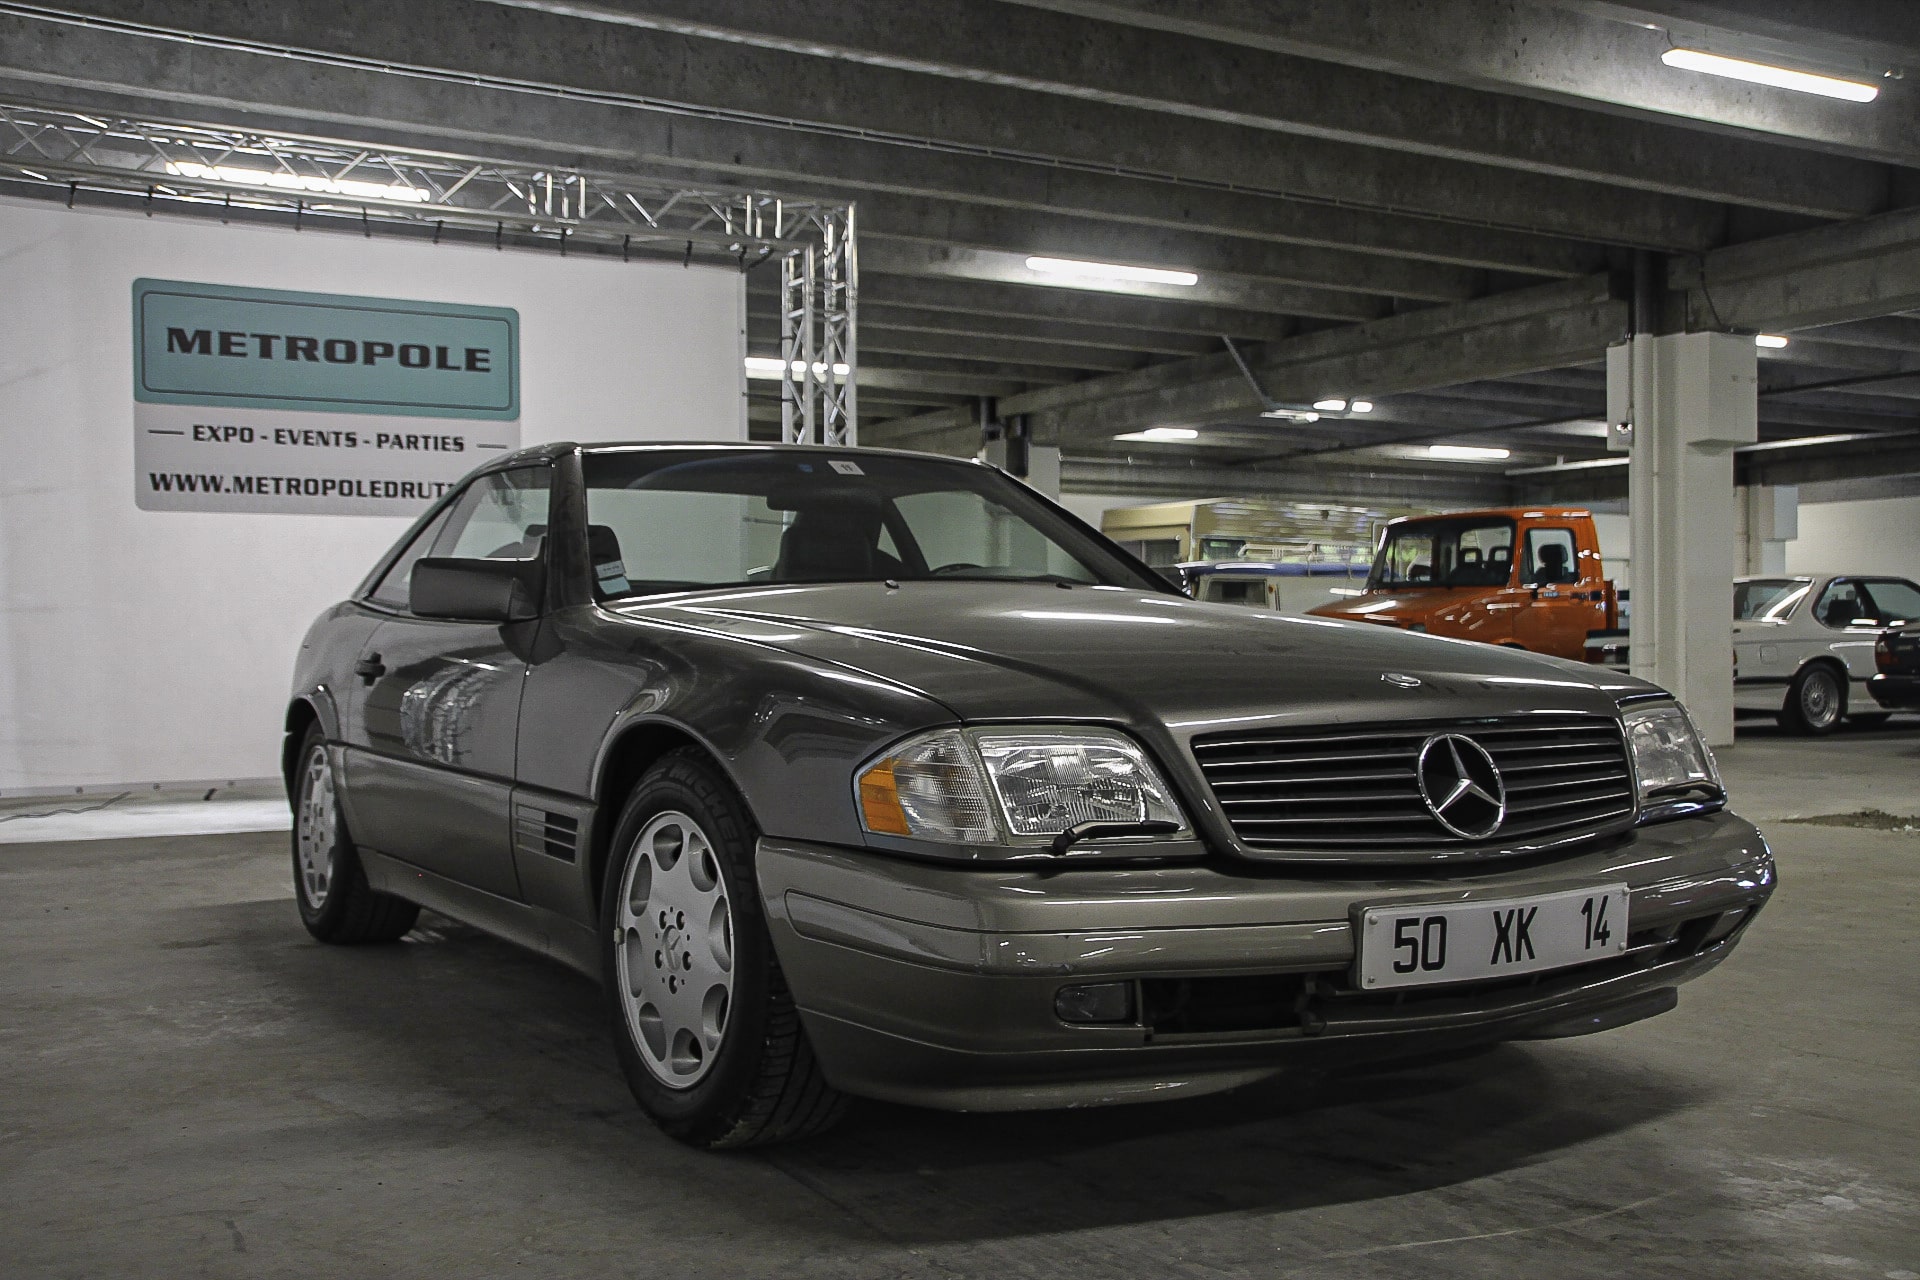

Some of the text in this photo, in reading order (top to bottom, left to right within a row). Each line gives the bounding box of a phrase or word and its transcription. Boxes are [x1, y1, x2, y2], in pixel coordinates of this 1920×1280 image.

[167, 327, 491, 373] METROPOLE
[192, 424, 255, 444] EXPO
[274, 428, 358, 448] EVENTS
[376, 432, 465, 453] PARTIES
[1393, 895, 1611, 974] 50 XK 14
